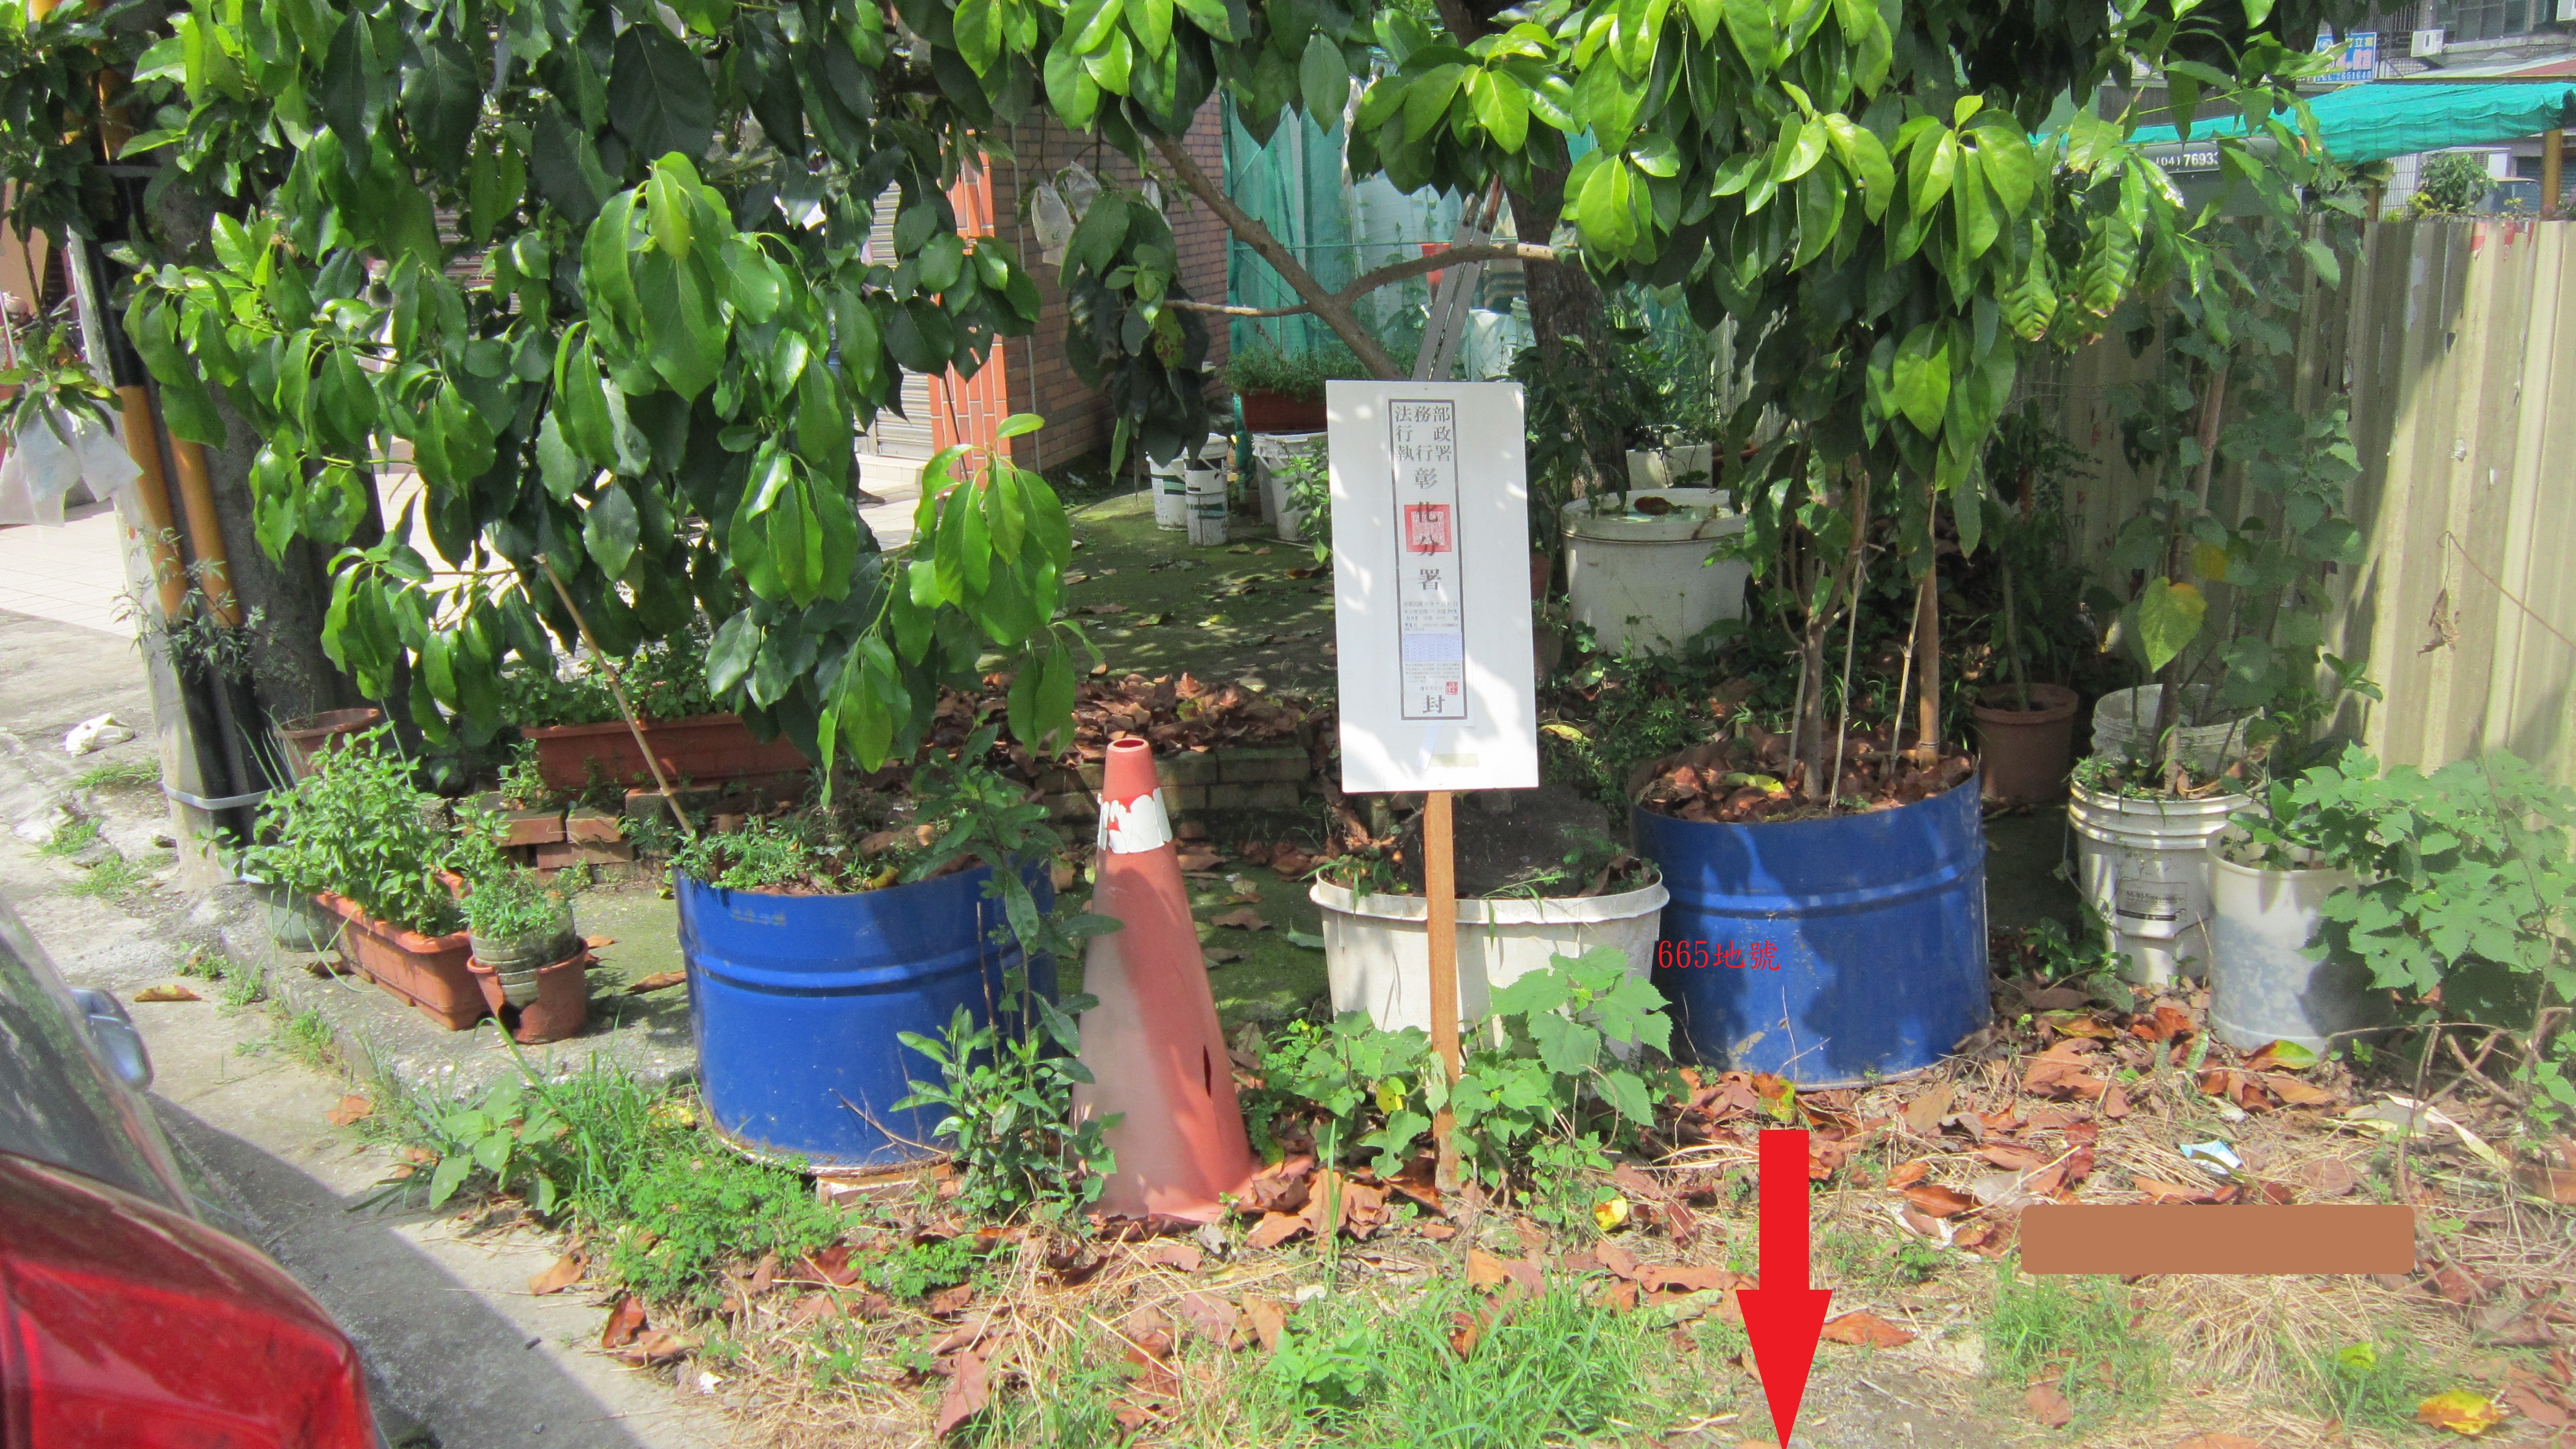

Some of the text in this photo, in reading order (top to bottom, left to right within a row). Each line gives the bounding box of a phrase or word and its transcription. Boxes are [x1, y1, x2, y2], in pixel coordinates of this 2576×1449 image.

[1395, 406, 1450, 423] 法務部
[1397, 445, 1452, 462] 執行署
